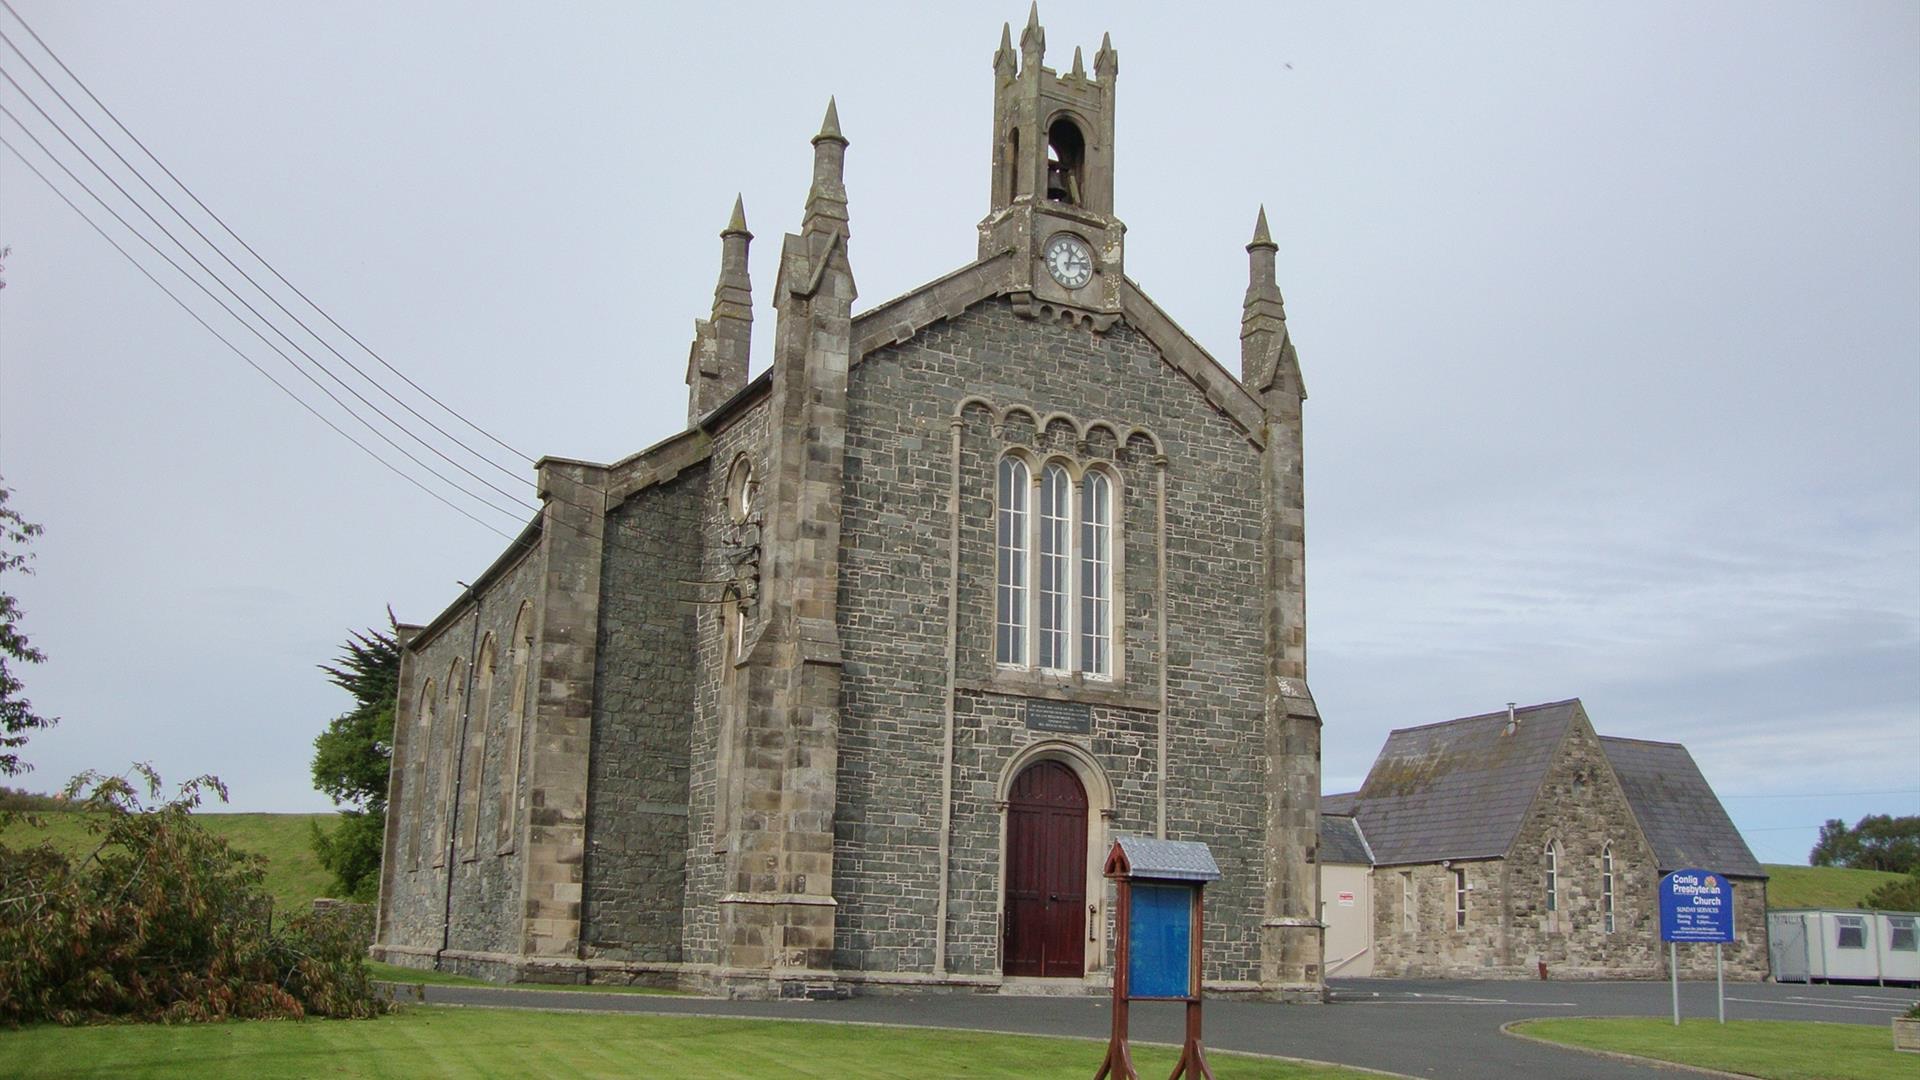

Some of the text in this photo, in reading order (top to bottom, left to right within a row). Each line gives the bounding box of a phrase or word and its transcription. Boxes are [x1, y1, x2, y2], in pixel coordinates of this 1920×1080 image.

[1673, 875, 1698, 885] Conlig
[1673, 884, 1720, 895] Presbyteran
[1693, 896, 1721, 905] Church
